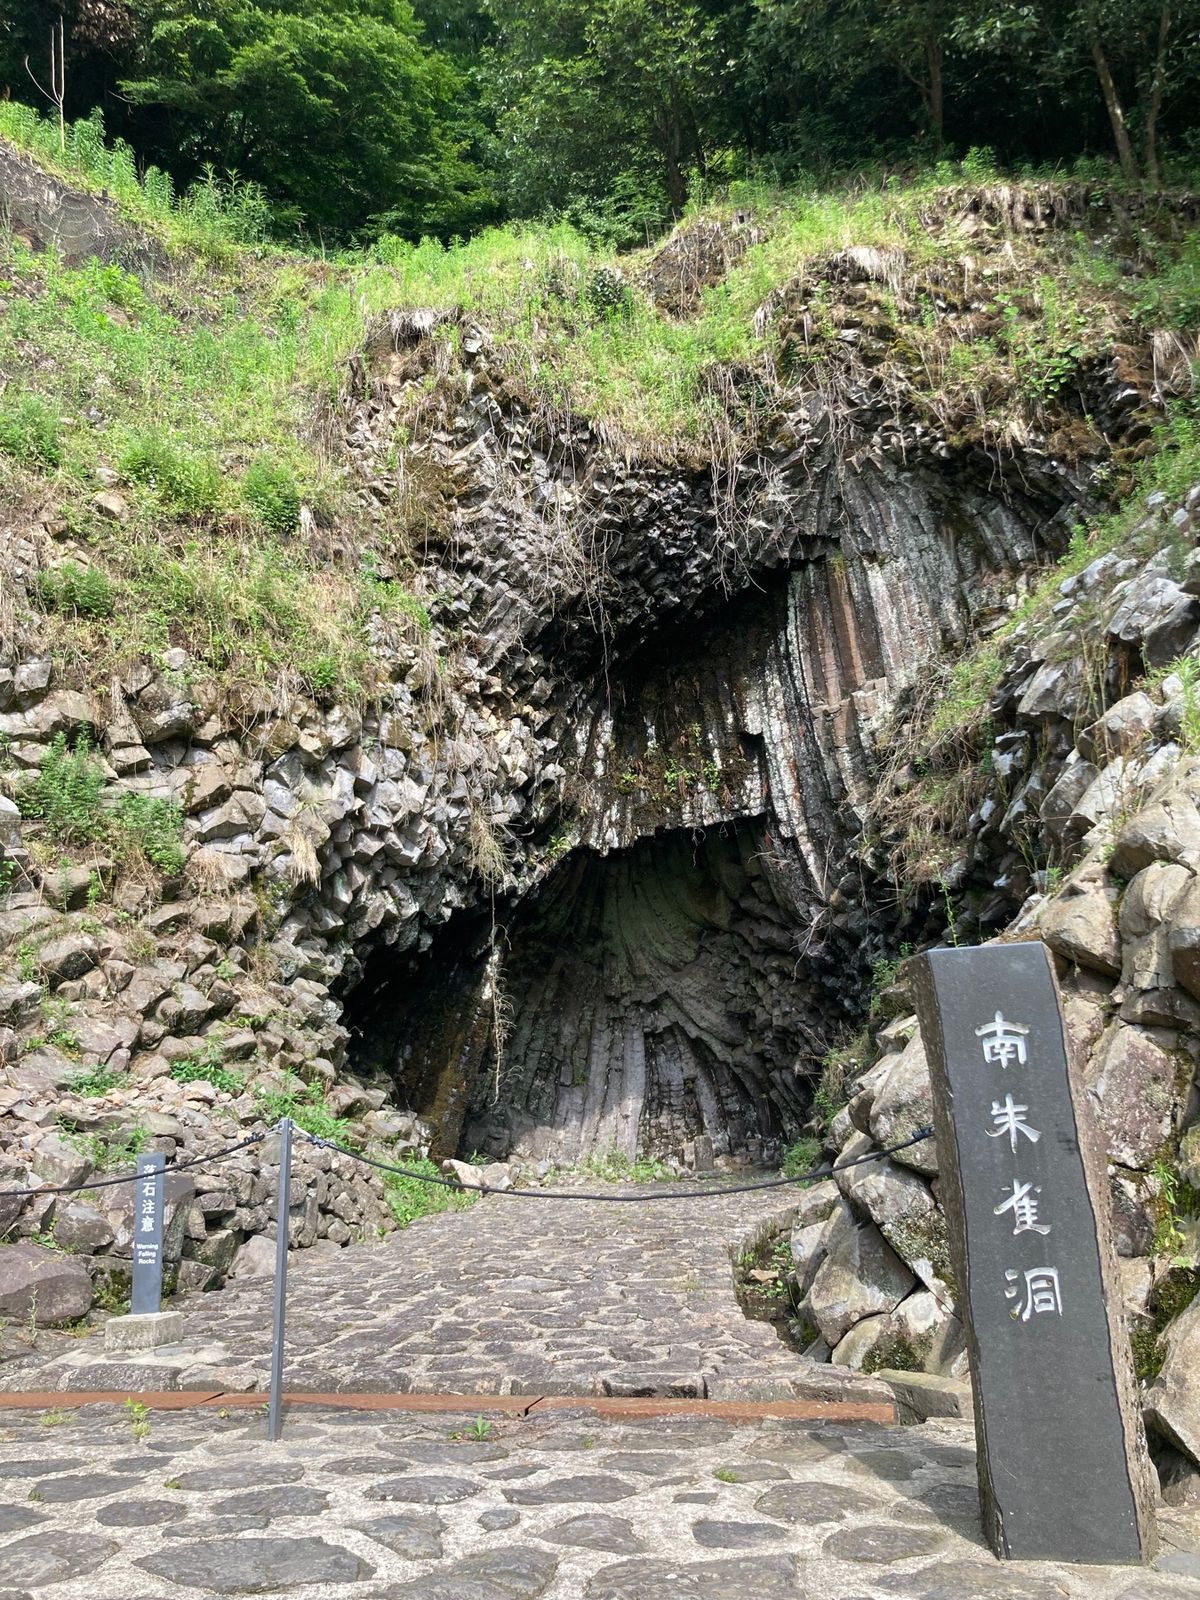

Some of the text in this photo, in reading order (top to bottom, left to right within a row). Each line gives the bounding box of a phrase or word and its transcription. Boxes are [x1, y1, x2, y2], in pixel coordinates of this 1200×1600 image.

[140, 1164, 157, 1232] 落石注意
[975, 1010, 1062, 1322] 南朱雀洞
[138, 1250, 157, 1258] Falling
